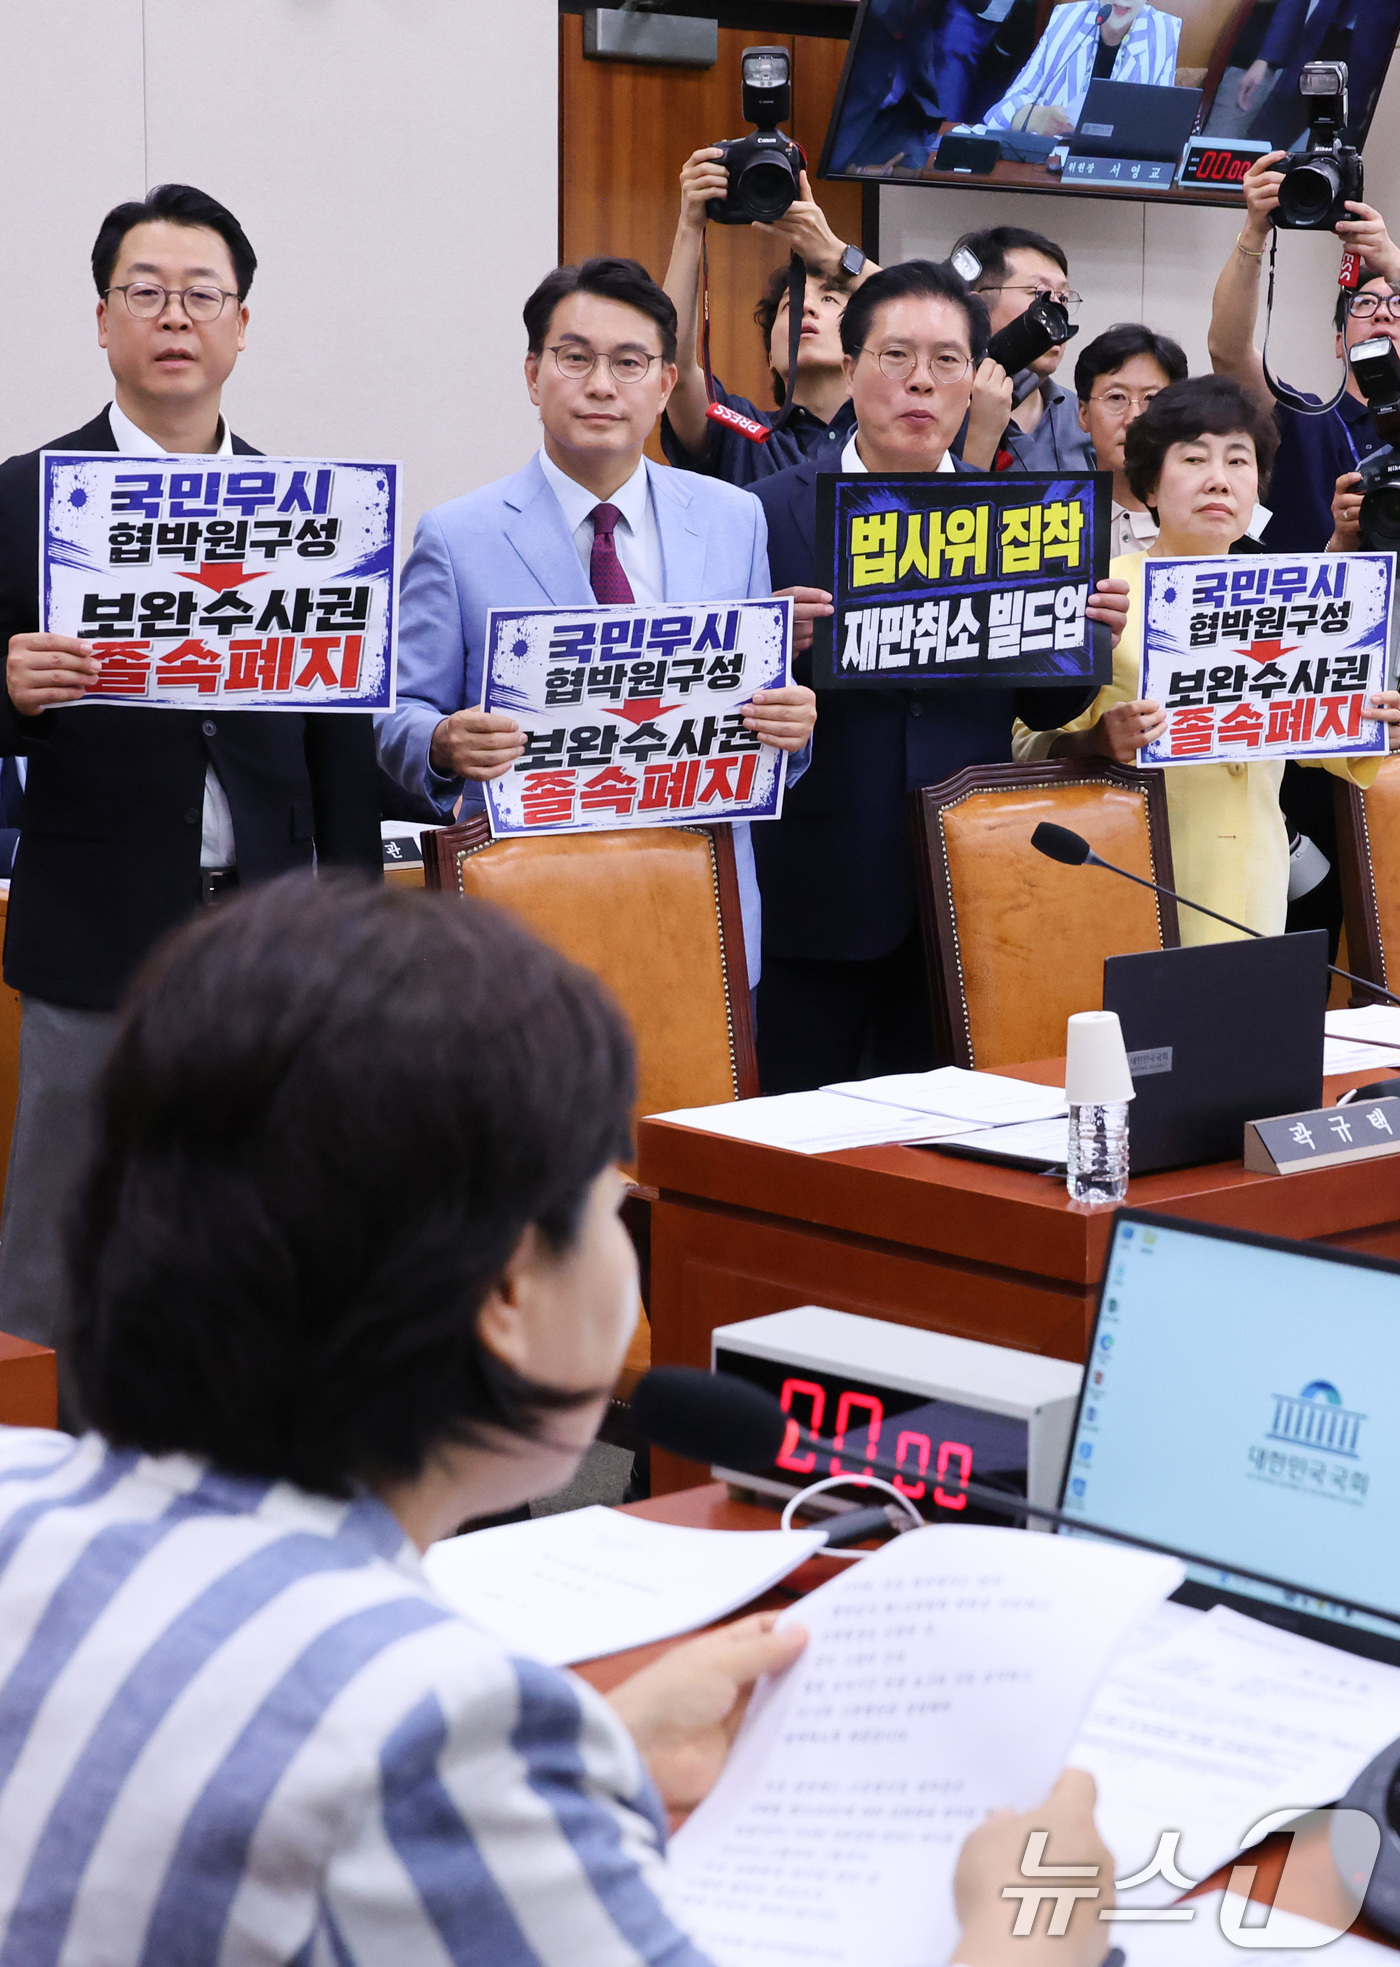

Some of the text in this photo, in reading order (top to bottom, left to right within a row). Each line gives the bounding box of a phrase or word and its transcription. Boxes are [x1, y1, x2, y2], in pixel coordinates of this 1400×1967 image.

[1068, 161, 1095, 174] 위원장
[713, 404, 761, 434] PRESS
[110, 469, 332, 519] 국민무시
[108, 518, 339, 563] 협박원구성
[850, 500, 1084, 588] 법사위 집착
[1192, 562, 1349, 609] 국민무시
[77, 586, 371, 639] 보완수사권
[548, 609, 740, 664] 국민무시
[841, 583, 1088, 672] 재판취소 빌드업
[1189, 601, 1351, 647] 협박원구성
[85, 634, 363, 694] 졸속폐지
[545, 653, 744, 705] 협박원구성
[1165, 654, 1371, 708] 보완수사권
[513, 713, 762, 771] 보완수사권
[1169, 693, 1364, 756] 졸속폐지
[520, 754, 757, 825] 졸속폐지
